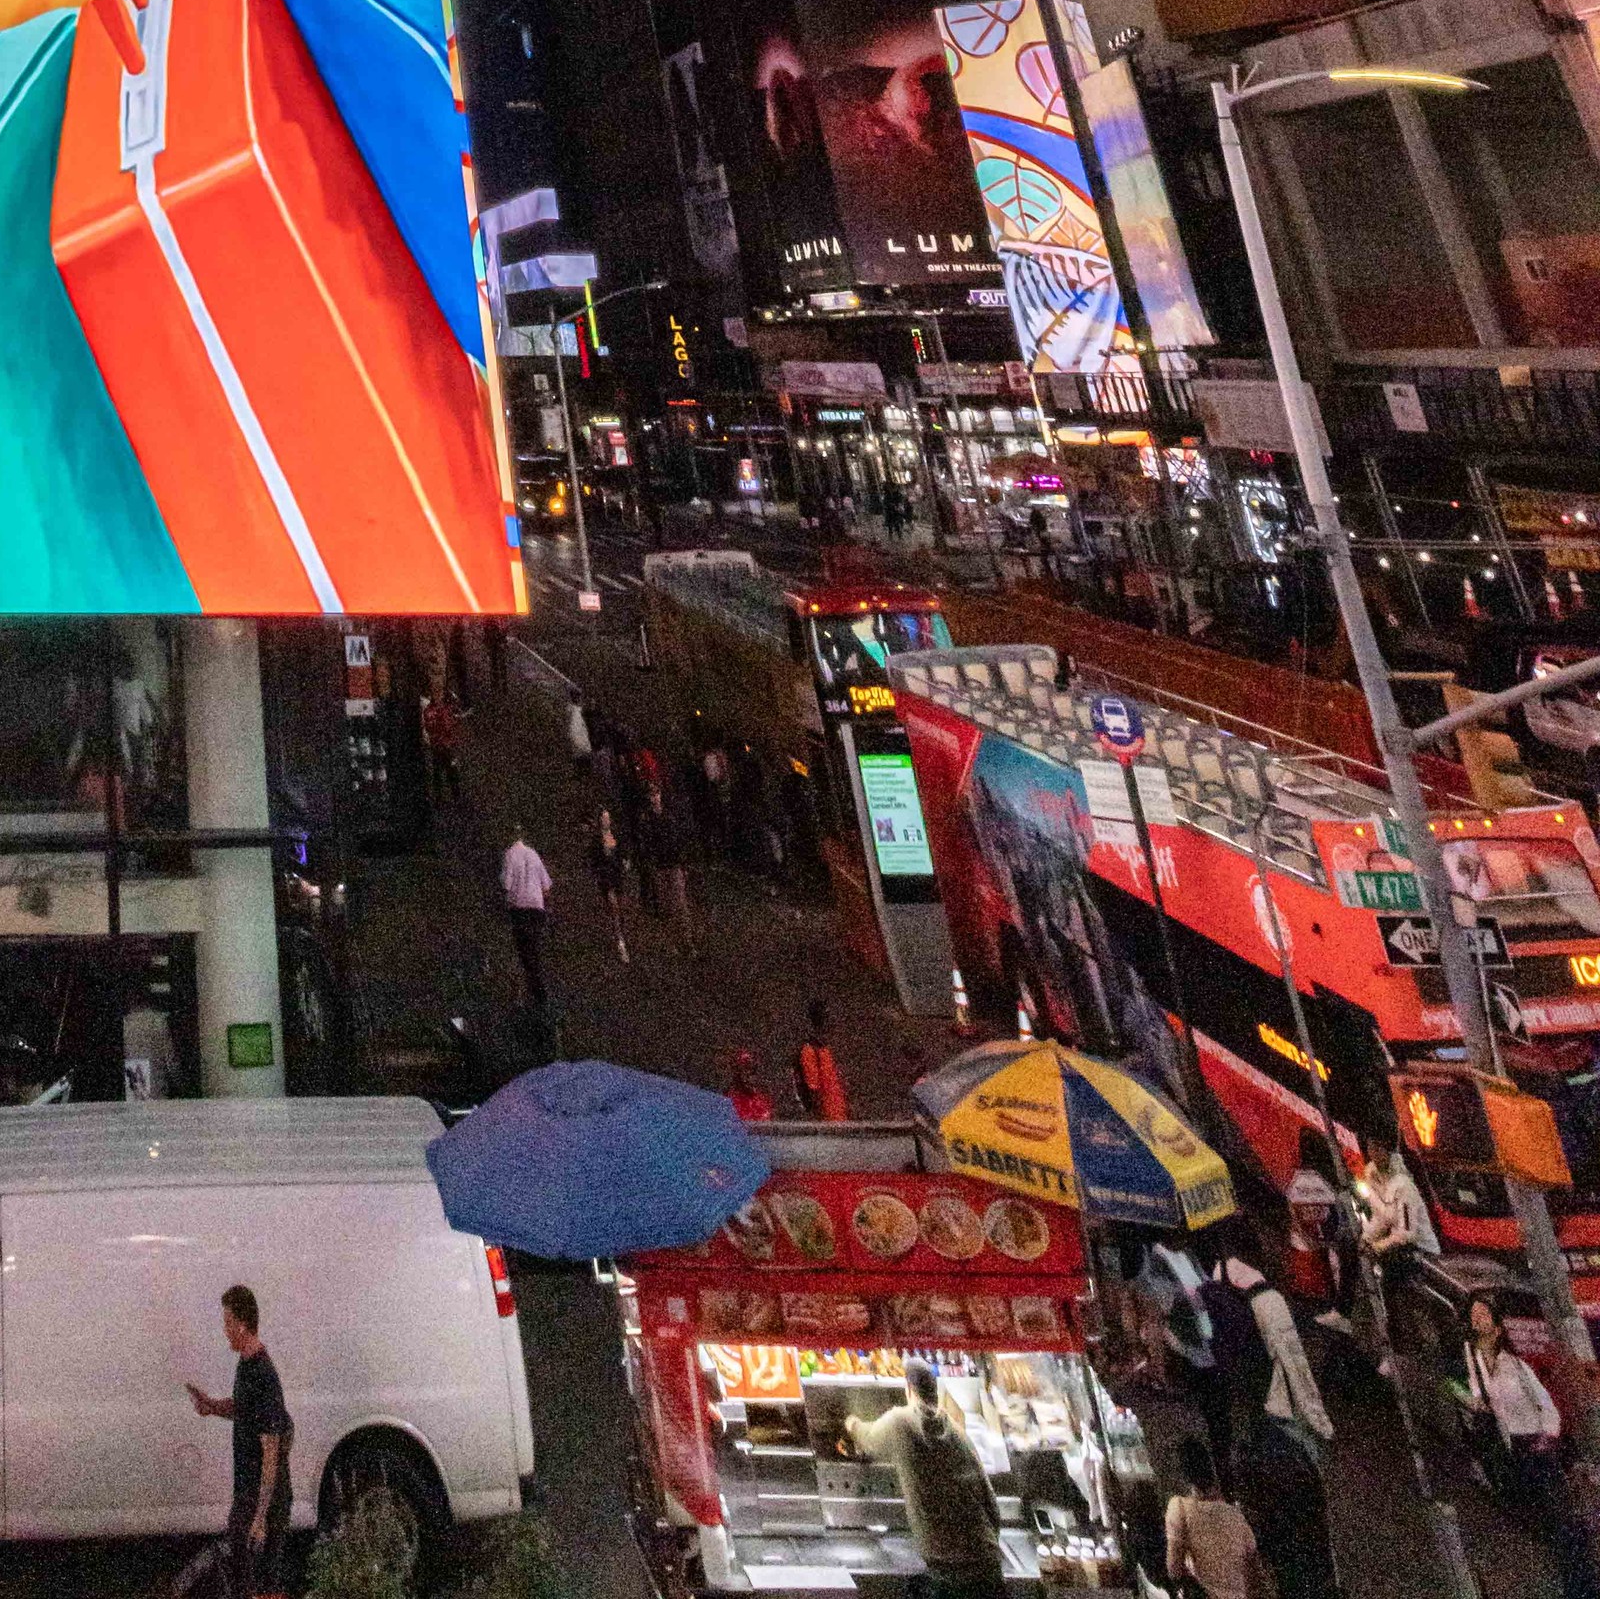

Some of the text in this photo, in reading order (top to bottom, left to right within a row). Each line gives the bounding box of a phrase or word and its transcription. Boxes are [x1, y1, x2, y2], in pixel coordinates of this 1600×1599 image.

[785, 236, 842, 263] LUMINA
[928, 264, 950, 272] ONLY
[952, 263, 962, 272] IN
[1381, 876, 1400, 904] 47
[1400, 933, 1433, 952] ONE
